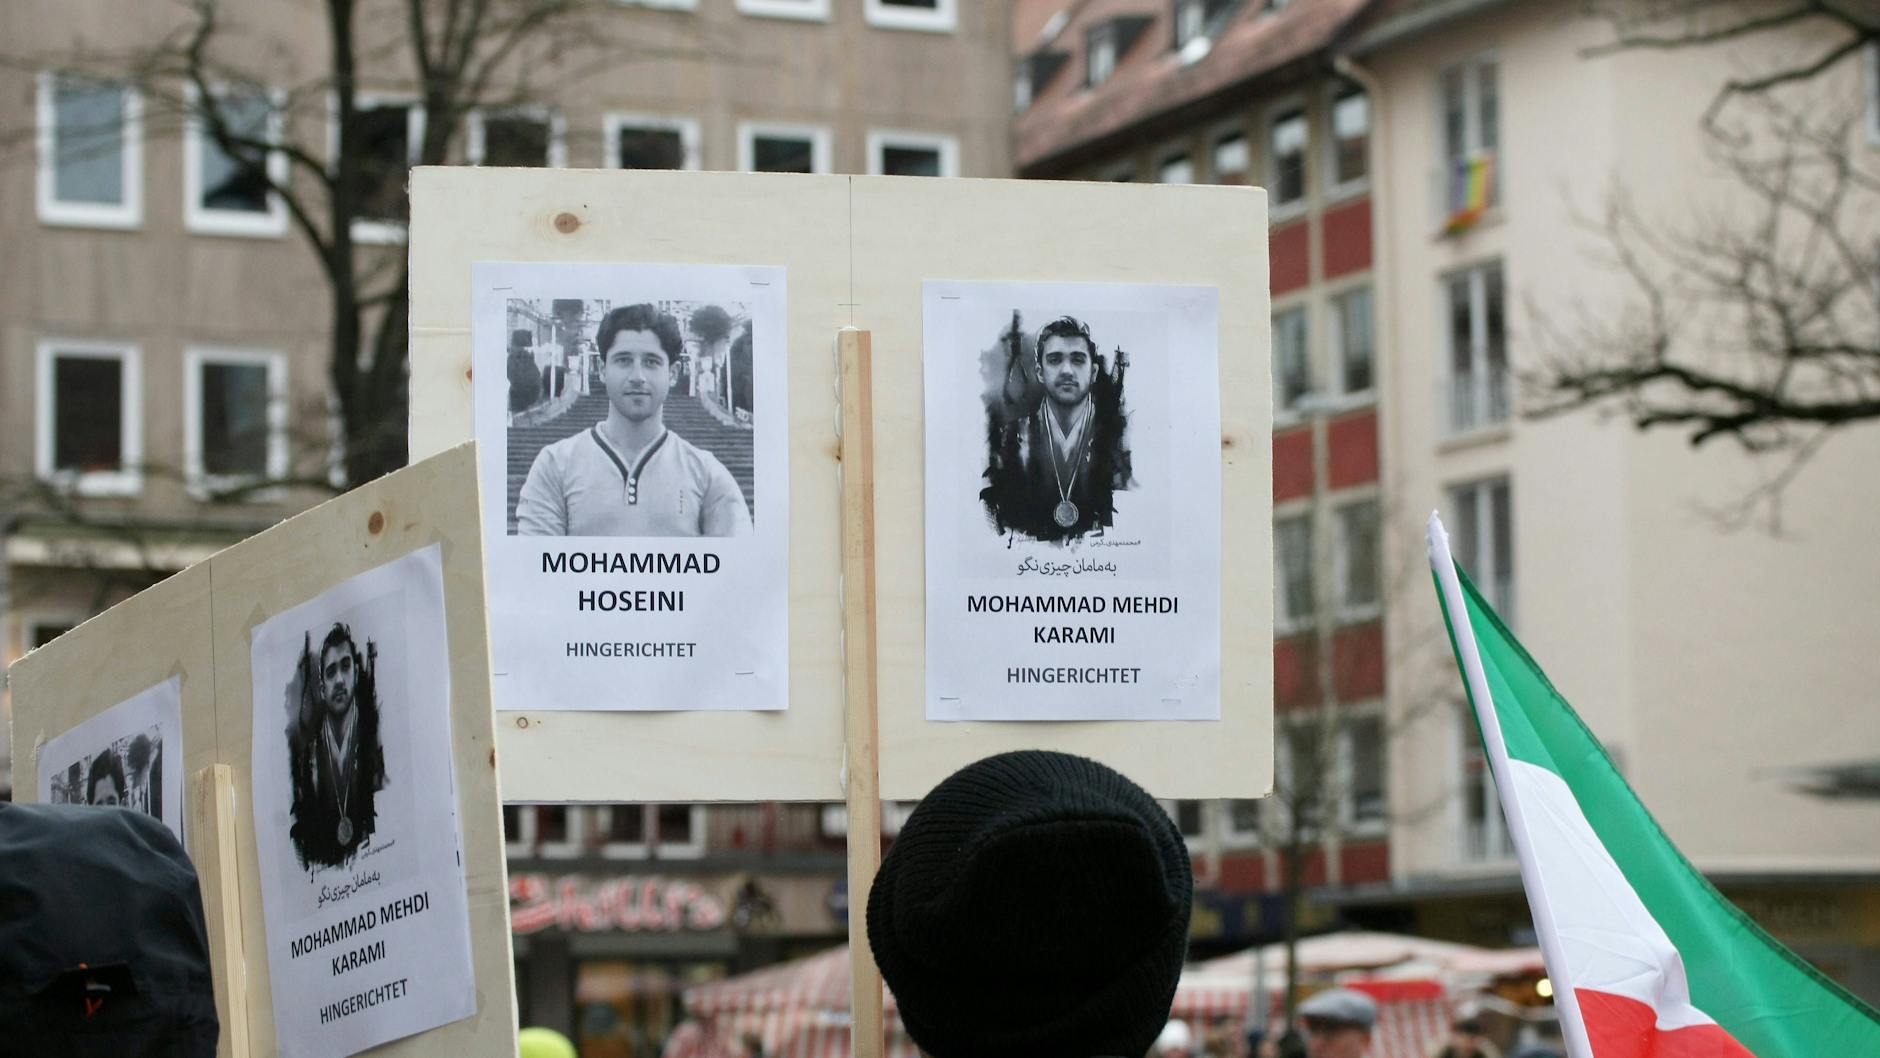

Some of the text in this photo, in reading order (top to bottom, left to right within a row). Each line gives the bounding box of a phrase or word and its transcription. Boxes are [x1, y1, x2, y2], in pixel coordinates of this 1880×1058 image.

[542, 552, 721, 574] MOHAMMAD
[578, 590, 684, 612] HOSEINI
[967, 595, 1178, 614] MOHAMMAD MEHDI
[1034, 626, 1115, 644] KARAMI
[566, 642, 697, 658] HINGERICHTET
[1007, 667, 1142, 684] HINGERICHTET
[290, 891, 429, 959] MOHAMMAD MEHDI
[331, 940, 386, 976] KARAMI
[319, 978, 409, 1025] HINGERICHTET
